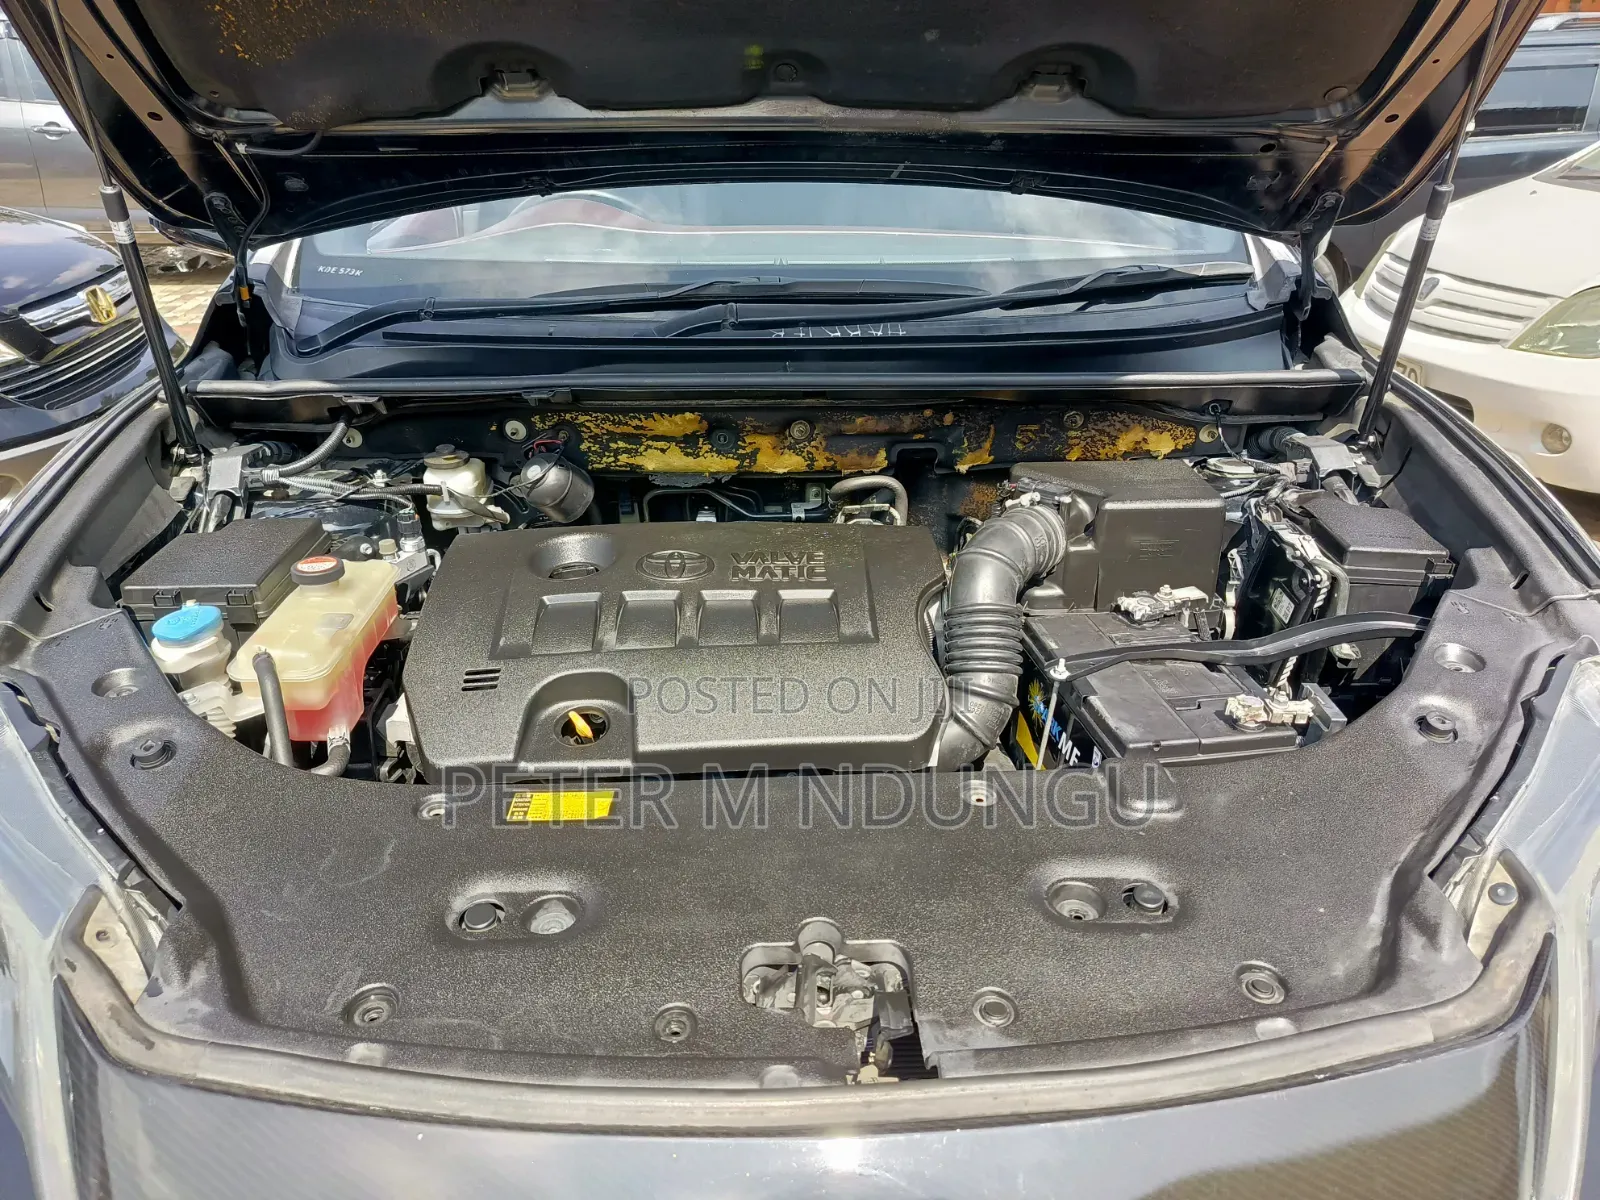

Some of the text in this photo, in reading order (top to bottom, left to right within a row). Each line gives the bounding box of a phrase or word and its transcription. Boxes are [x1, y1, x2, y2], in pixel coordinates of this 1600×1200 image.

[317, 265, 338, 273] KDE
[730, 551, 826, 565] VALVE
[730, 565, 828, 581] MATIC
